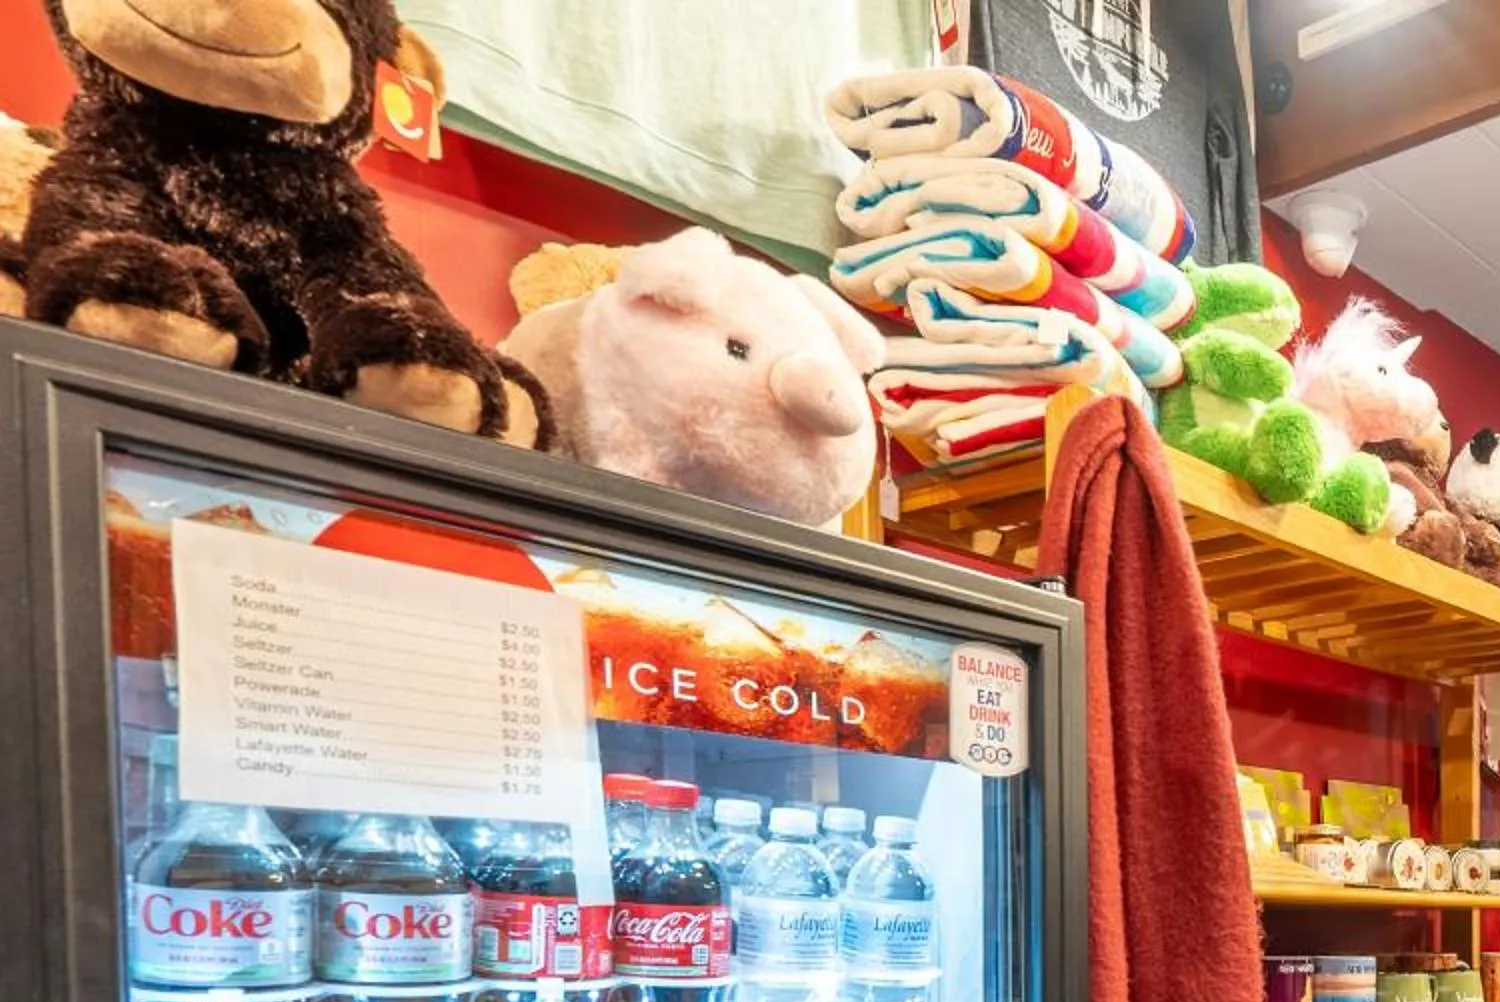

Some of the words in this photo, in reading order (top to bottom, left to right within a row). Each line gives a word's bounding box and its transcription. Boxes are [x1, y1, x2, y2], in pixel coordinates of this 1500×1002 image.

[230, 575, 277, 593] Soda
[231, 594, 301, 617] Monster
[232, 616, 278, 633] Juice
[233, 634, 293, 654] Seltzer
[233, 655, 293, 675] Seltzer
[299, 665, 334, 681] Can
[957, 654, 1025, 683] BALANCE
[233, 675, 320, 697] Powerade
[604, 657, 699, 702] ICE
[732, 678, 867, 726] COLD
[976, 688, 1002, 707] EAT
[234, 696, 299, 716] Vitamin
[304, 704, 352, 721] Water
[969, 704, 1012, 727] DRINK
[235, 717, 287, 733] Smart
[293, 723, 343, 740] Water
[987, 724, 1006, 742] DO
[235, 737, 315, 755] Lafayette
[320, 745, 368, 761] Water
[236, 757, 294, 777] Candy
[142, 893, 274, 939] Coke
[333, 900, 453, 940] Coke
[608, 908, 710, 945] Coca-Cola
